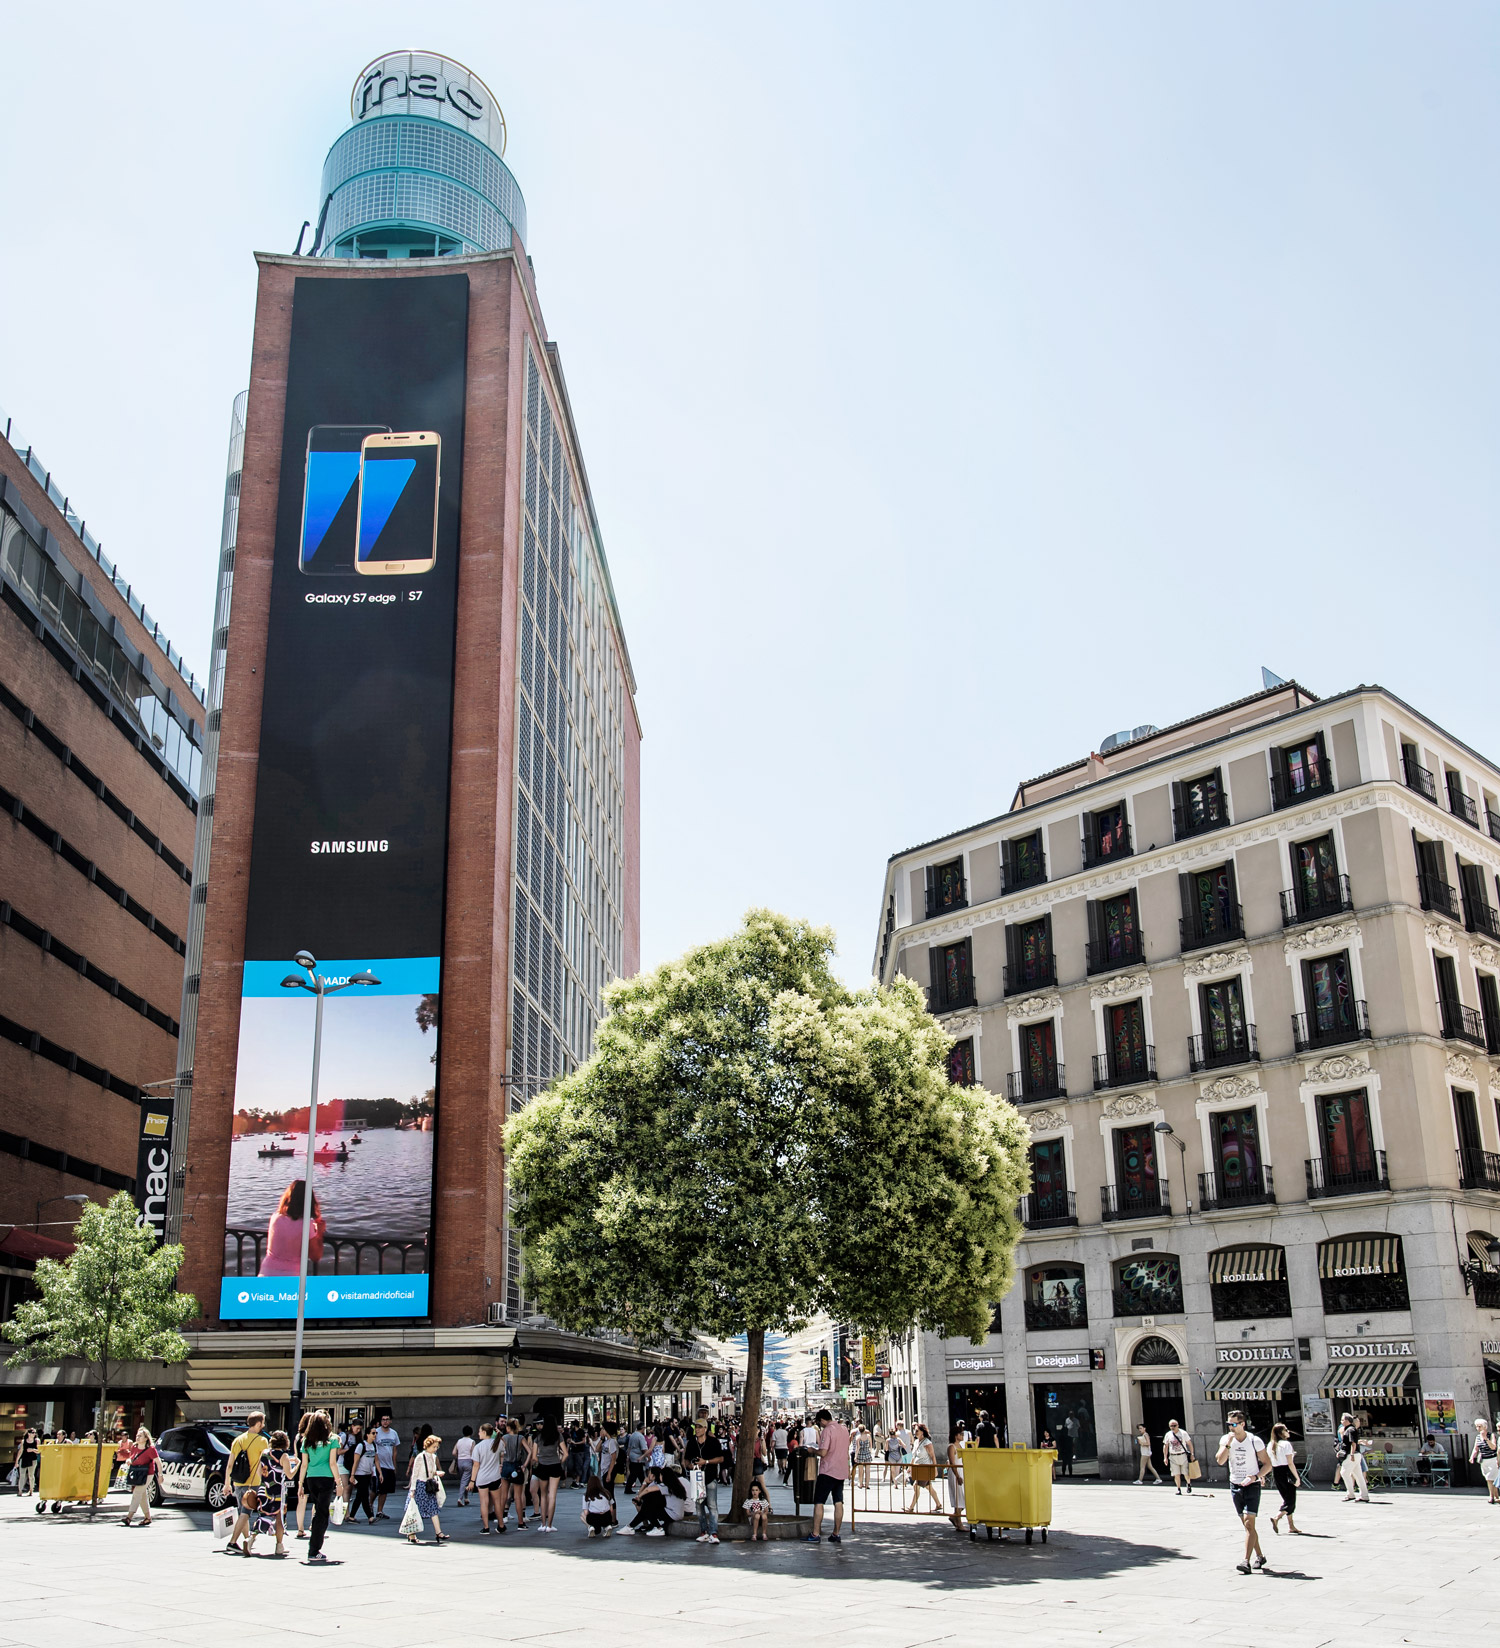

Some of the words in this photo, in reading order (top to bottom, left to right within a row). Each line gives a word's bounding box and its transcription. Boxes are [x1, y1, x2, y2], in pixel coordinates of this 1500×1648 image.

[357, 68, 483, 120] fnac
[305, 592, 351, 605] Galaxy
[352, 593, 367, 603] S7
[368, 593, 396, 605] edge
[408, 590, 423, 601] S7
[310, 839, 389, 854] SAMSUNG
[146, 1116, 168, 1125] fnac
[1222, 1272, 1265, 1283] RODILLA
[1334, 1265, 1382, 1278] RODILLA
[340, 1290, 415, 1300] visitamadridoficial
[1219, 1347, 1293, 1362] RODILLA
[1330, 1342, 1412, 1358] RODILLA
[1221, 1391, 1265, 1400] RODILLA
[1336, 1388, 1386, 1398] RODILLA
[170, 1482, 191, 1490] MADRID
